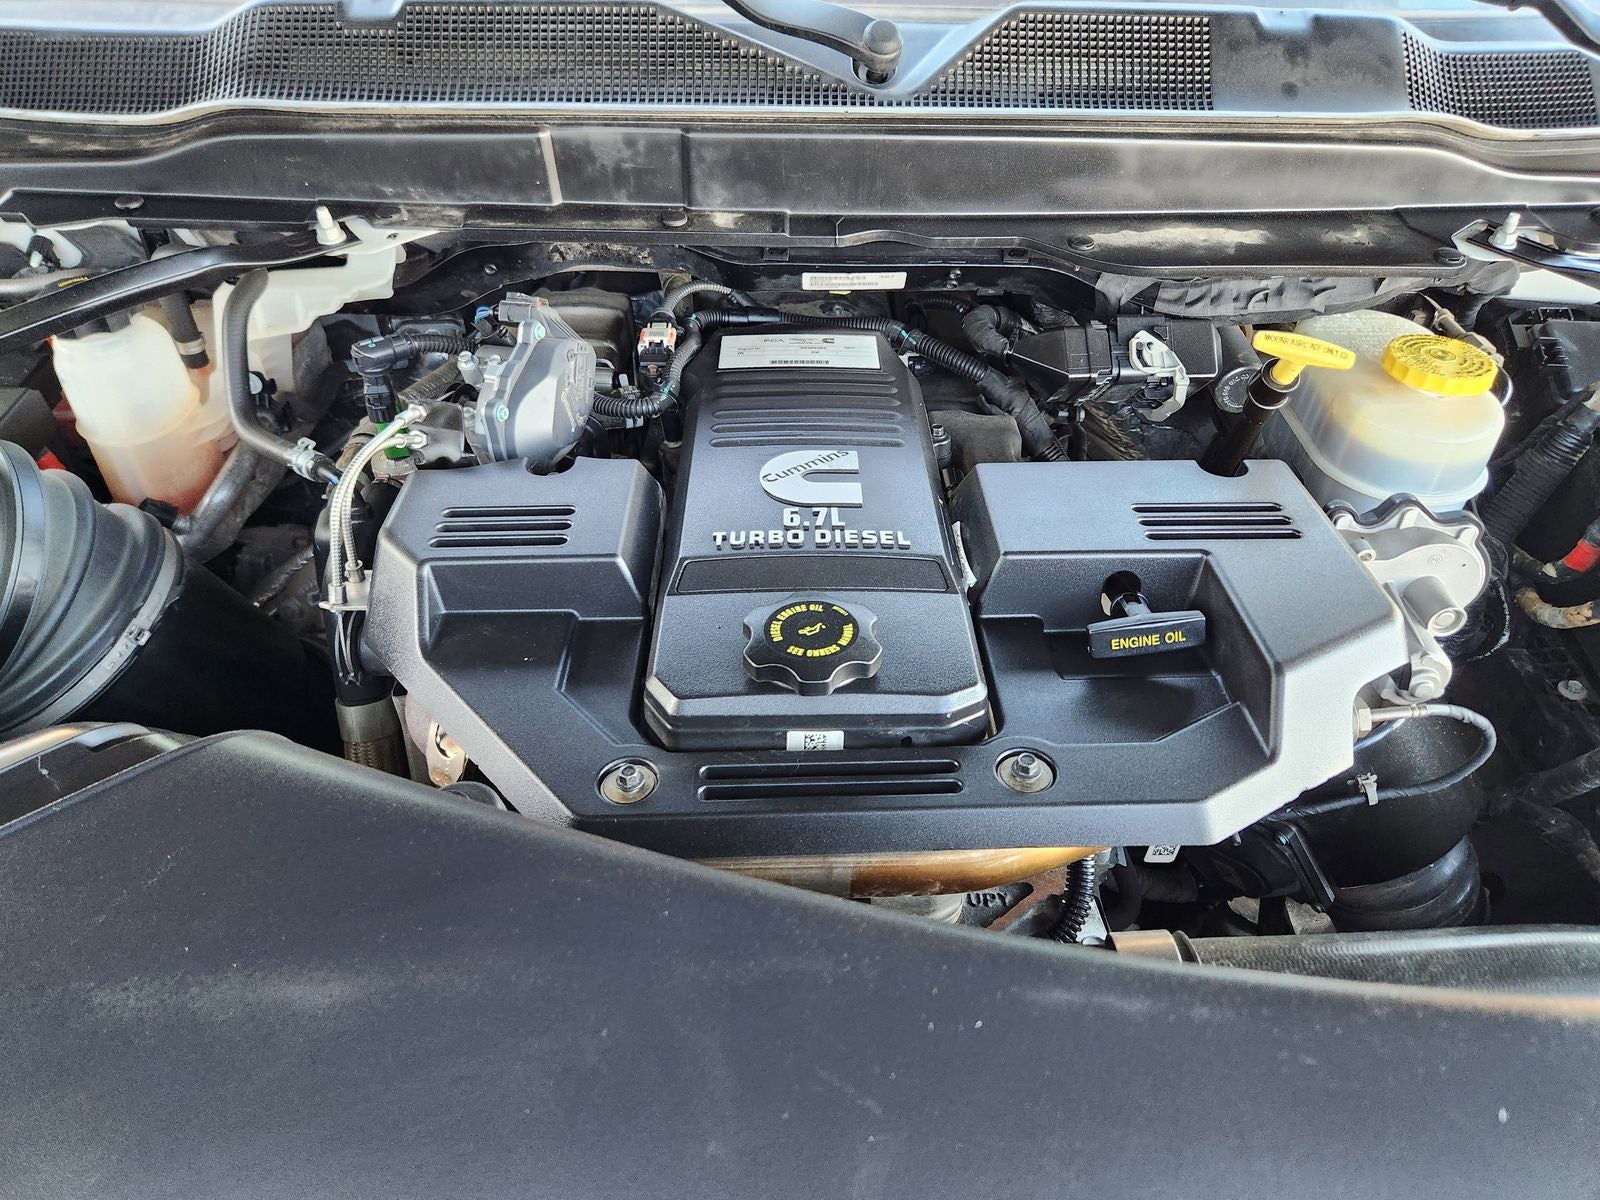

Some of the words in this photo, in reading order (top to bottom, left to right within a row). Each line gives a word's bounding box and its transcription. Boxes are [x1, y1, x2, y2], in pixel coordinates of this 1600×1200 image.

[1264, 334, 1288, 344] MOPAR
[762, 450, 849, 483] Cummins
[783, 507, 846, 529] 6.7L
[712, 530, 804, 550] TURBO
[814, 529, 911, 549] DIESEL
[776, 604, 808, 621] ENGINE
[809, 604, 824, 612] OIL
[1111, 634, 1160, 650] ENGINE
[1165, 631, 1186, 643] OIL
[786, 645, 805, 656] SEE
